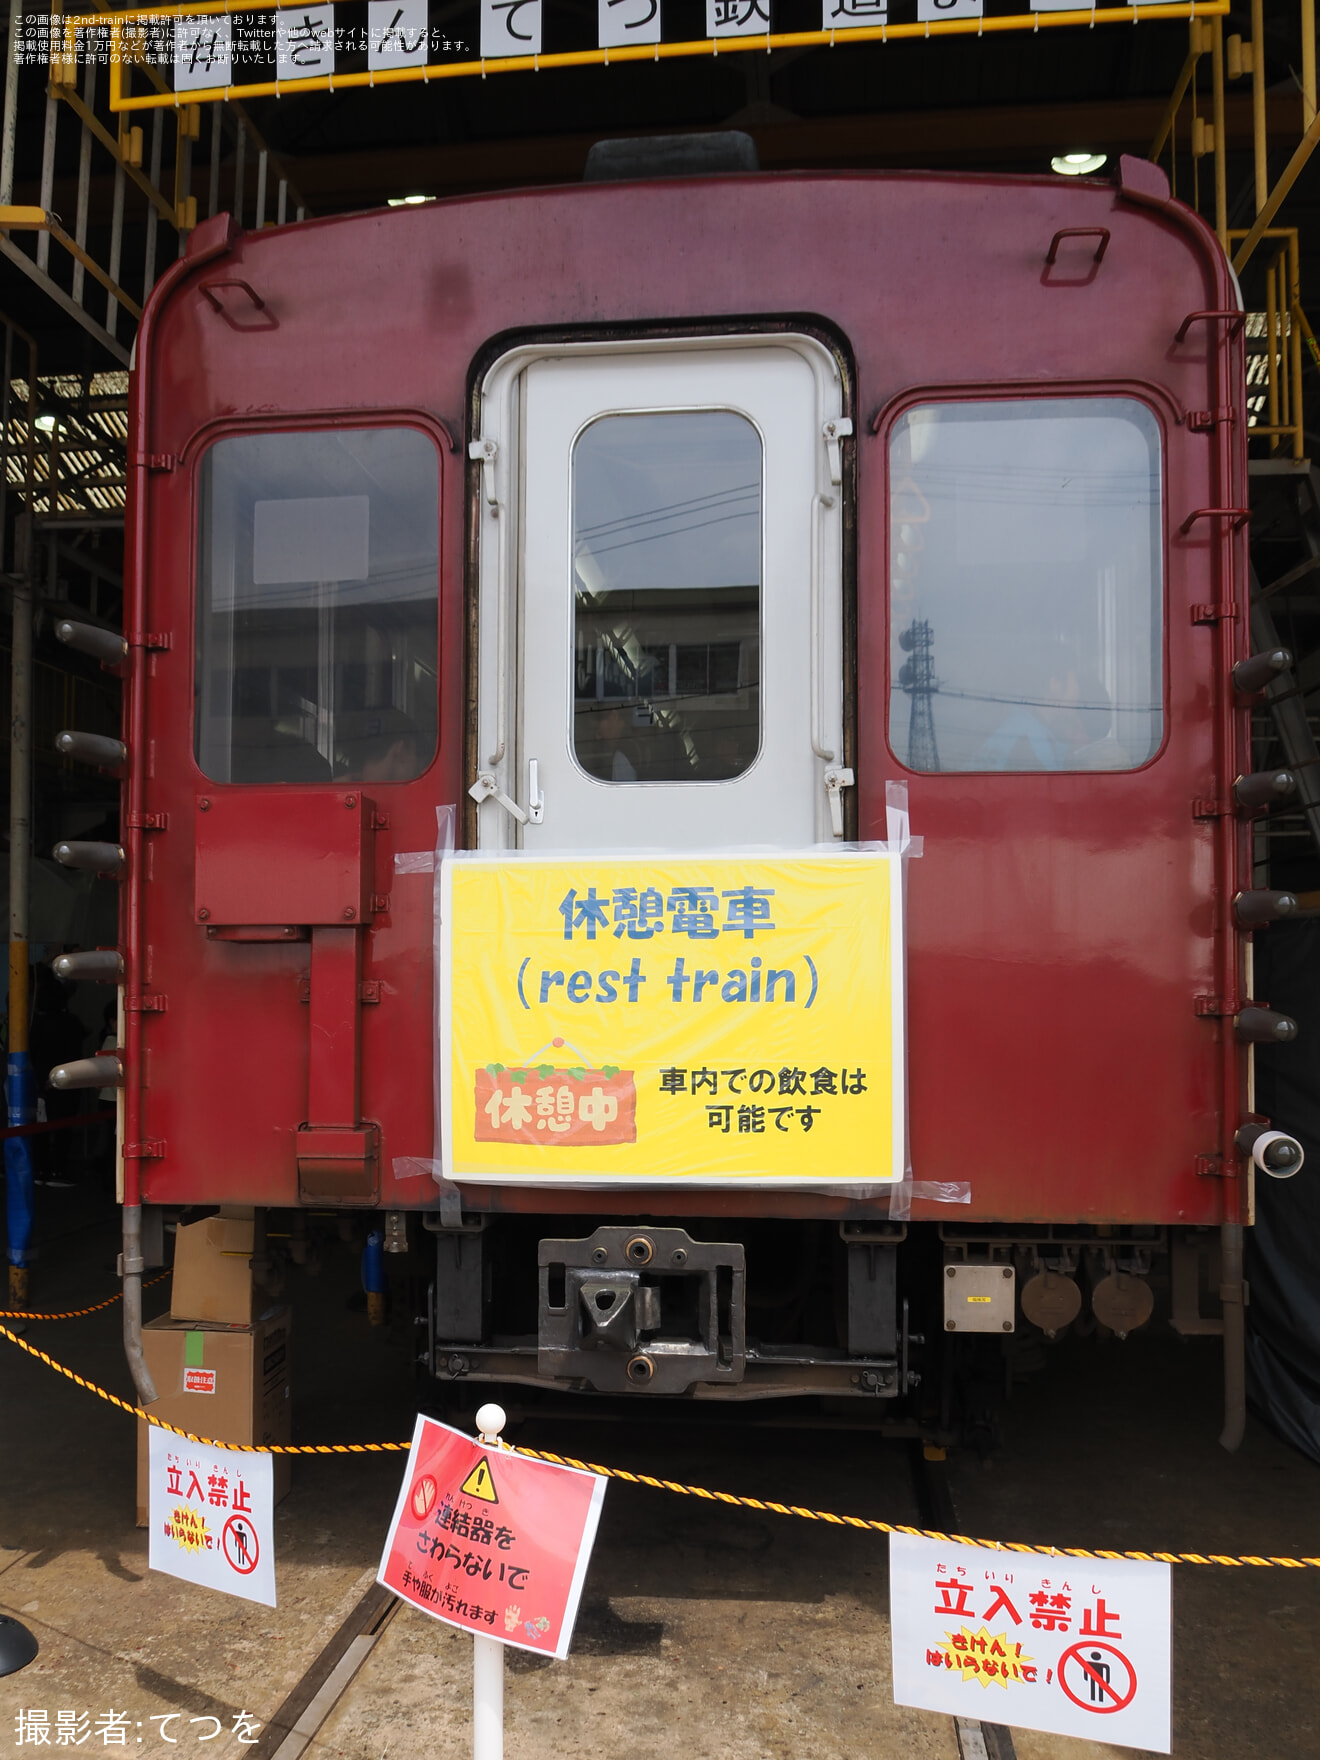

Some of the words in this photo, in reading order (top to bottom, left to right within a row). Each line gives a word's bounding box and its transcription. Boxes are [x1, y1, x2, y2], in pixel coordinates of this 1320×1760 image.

[558, 886, 776, 940] 休憩電車
[517, 957, 647, 1010] (rest
[666, 955, 819, 1009] train)
[658, 1067, 868, 1096] 車内での飲食は
[484, 1086, 619, 1133] 休憩中
[704, 1104, 822, 1134] 可能です
[166, 1464, 252, 1513] 立入禁止
[435, 1500, 516, 1551] 連結器を
[416, 1530, 530, 1591] さわらないで
[402, 1570, 499, 1626] 手や服が汚れます
[934, 1577, 1123, 1640] 立入禁止
